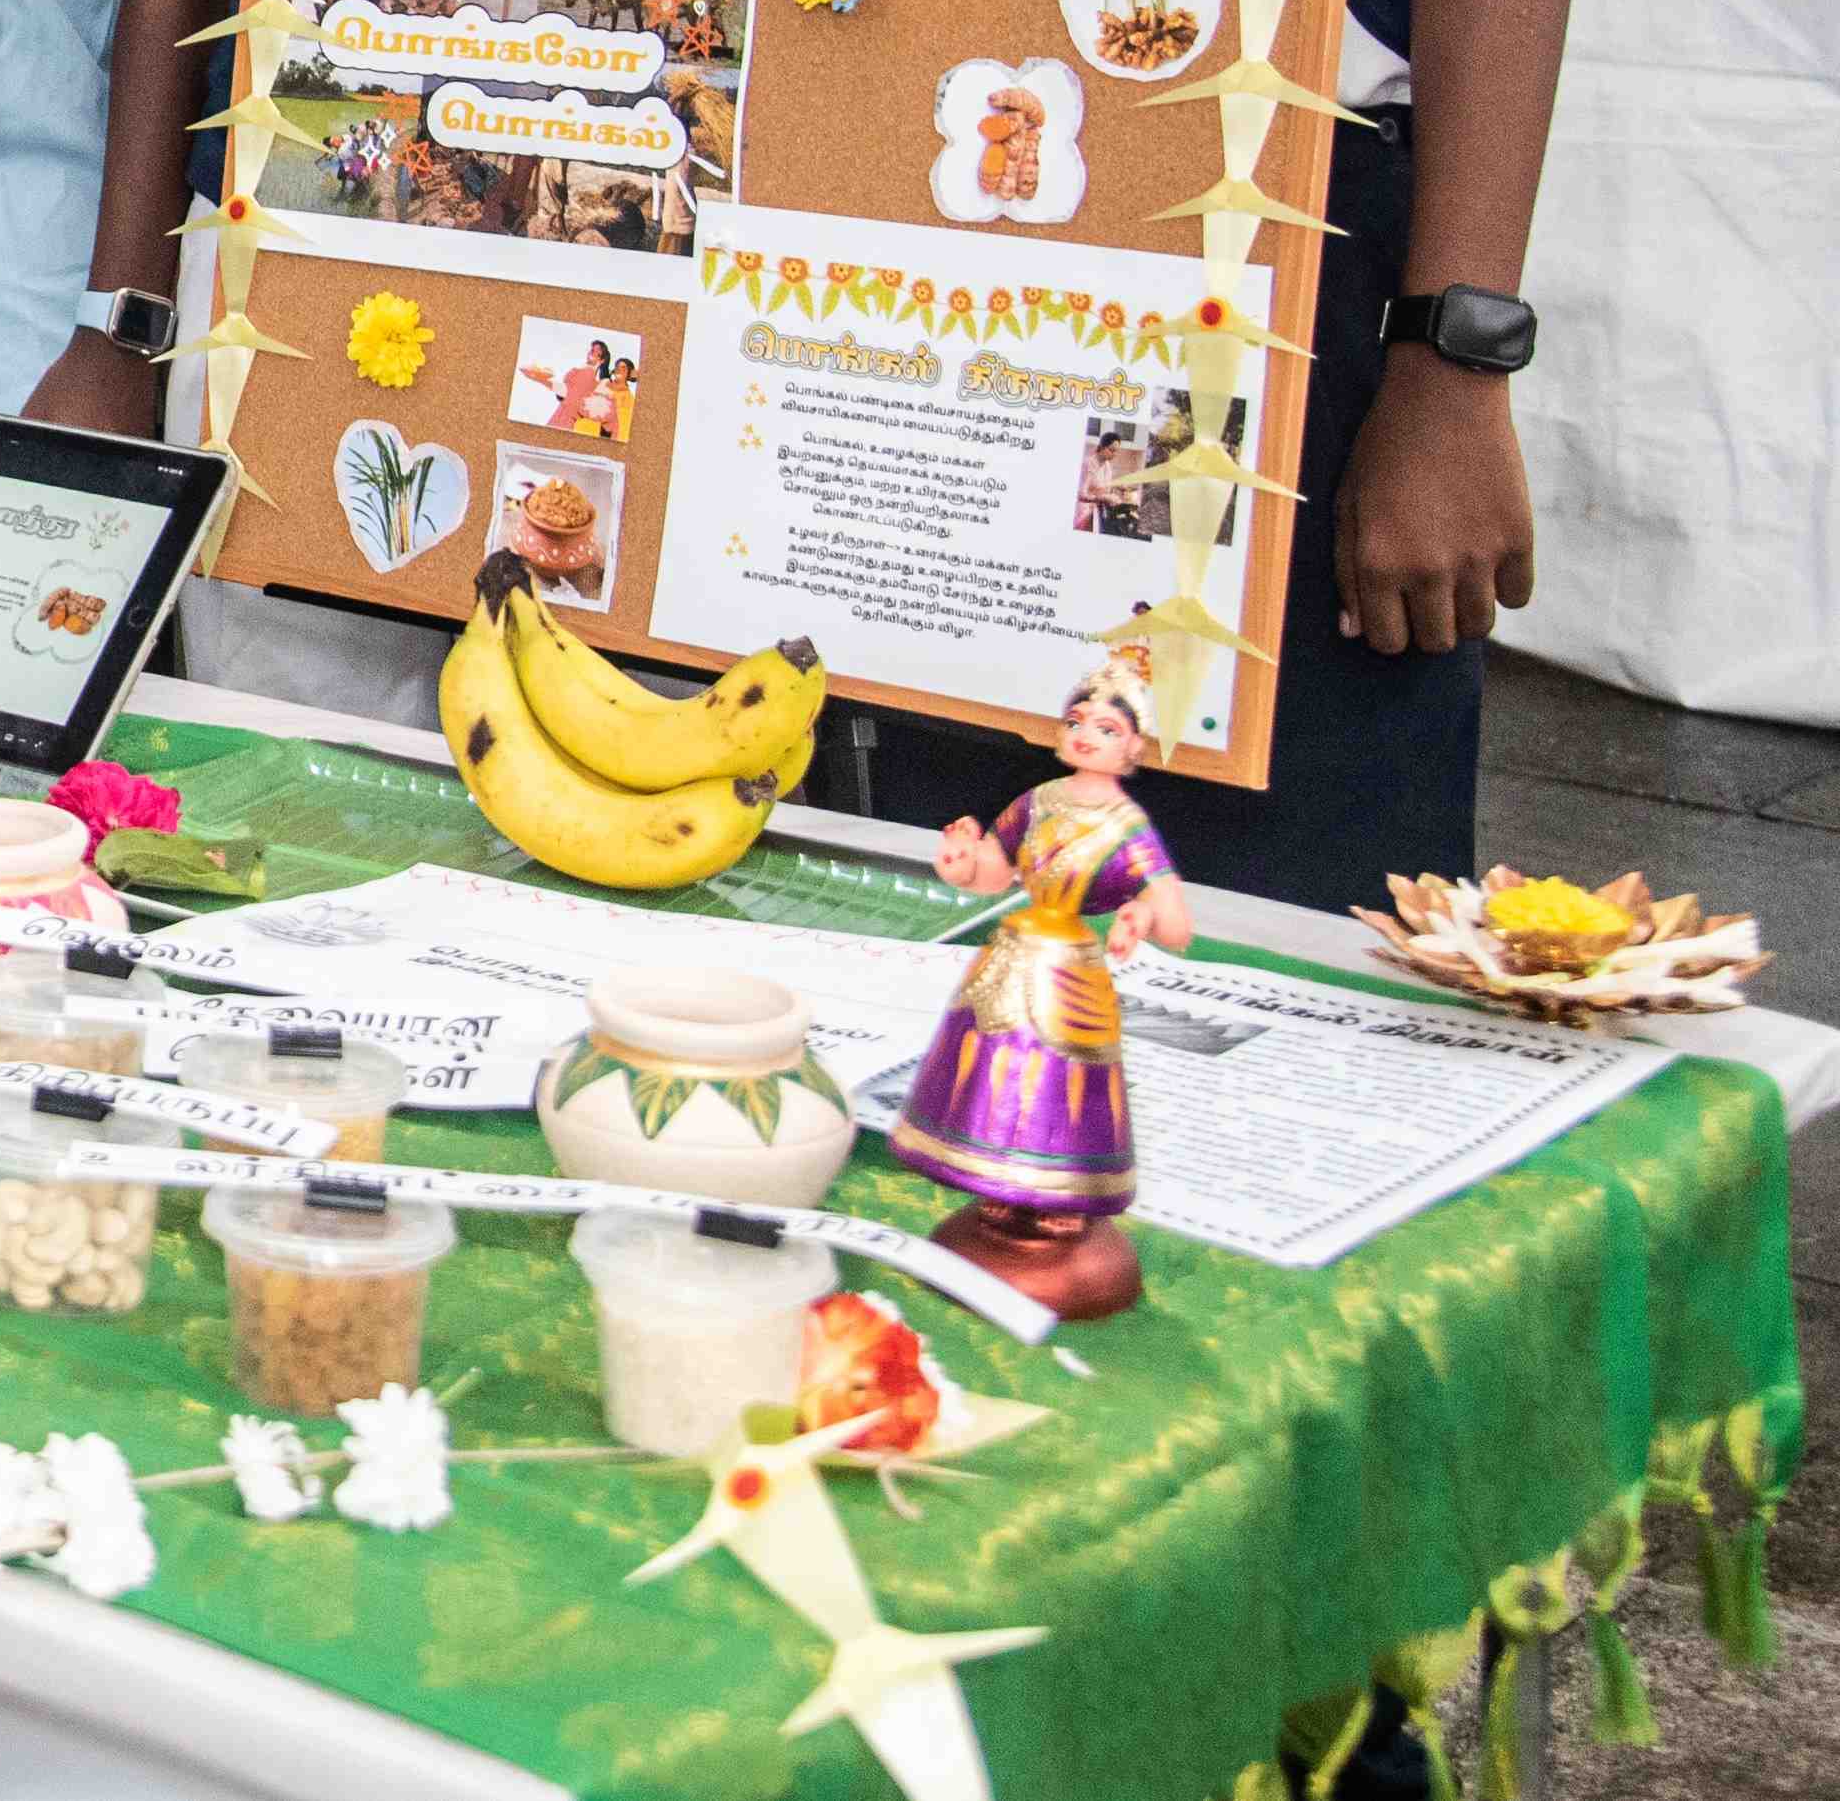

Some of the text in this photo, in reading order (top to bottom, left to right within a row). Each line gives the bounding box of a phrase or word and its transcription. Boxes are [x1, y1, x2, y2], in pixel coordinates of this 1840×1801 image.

[335, 16, 649, 74] பொங்கலோ
[441, 98, 672, 151] பொங்கல்
[742, 322, 1145, 415] பொங்கல் திருநாள்
[1147, 974, 1578, 1065] பொங்கல் திருநாள்
